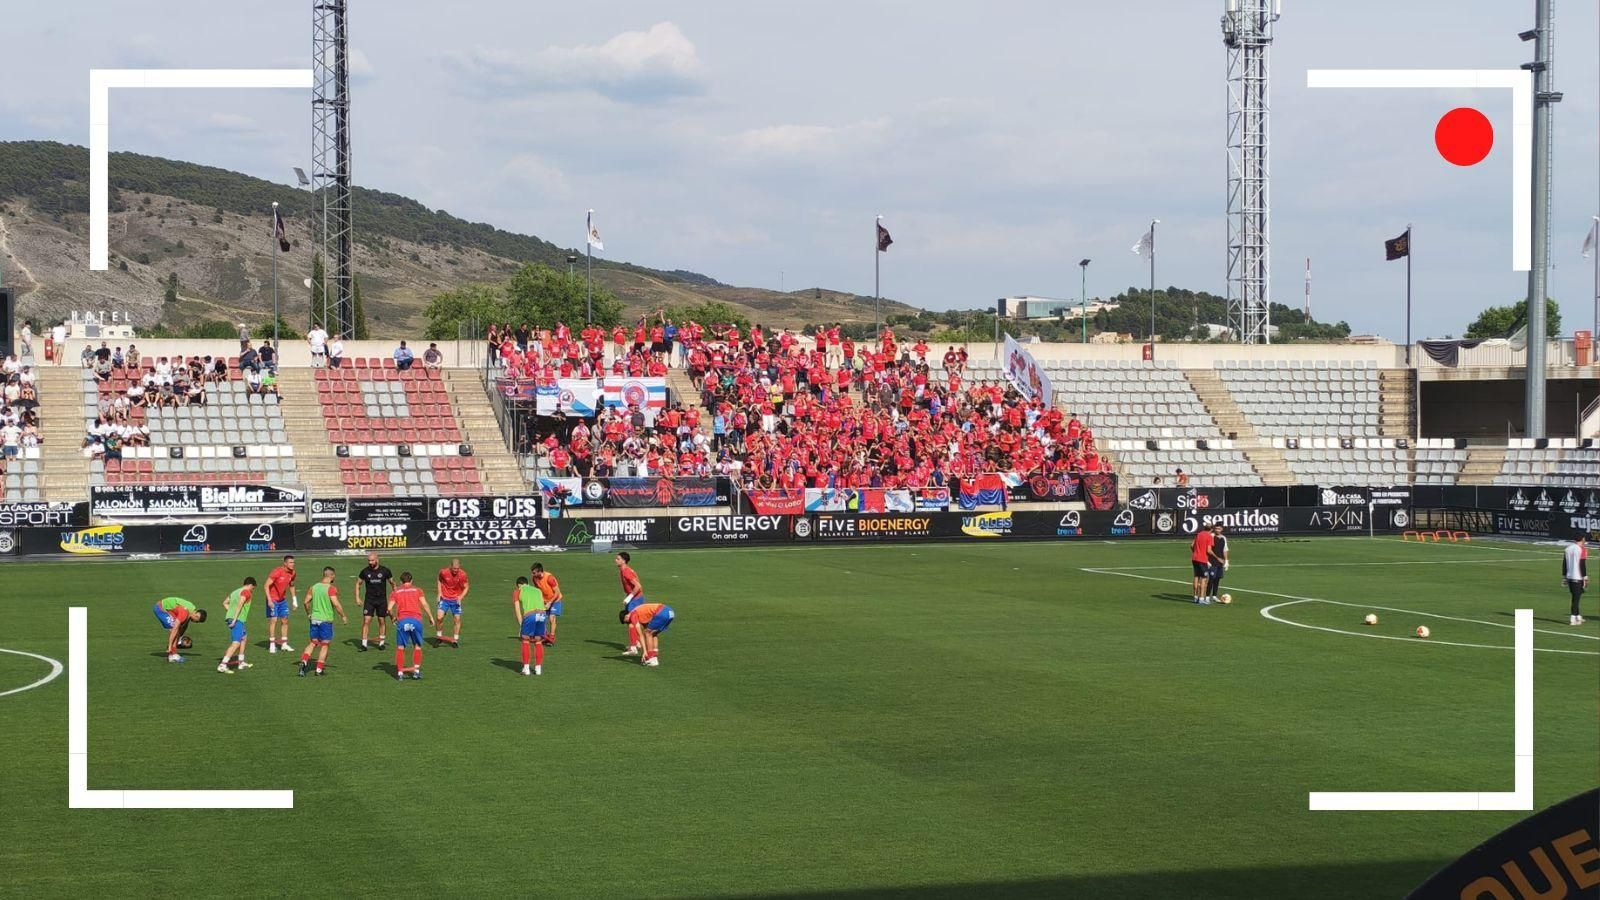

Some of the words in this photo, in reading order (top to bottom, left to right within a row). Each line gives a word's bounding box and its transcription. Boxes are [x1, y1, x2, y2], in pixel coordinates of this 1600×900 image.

[71, 310, 131, 322] HOTEL
[201, 487, 264, 506] BigMat
[11, 503, 33, 511] CASA
[95, 500, 143, 509] SALOMON
[149, 499, 196, 508] SALOMON
[0, 511, 73, 525] SPORT
[678, 516, 781, 531] GRENERGY
[819, 519, 854, 531] FIVE
[859, 518, 930, 531] BIOENERGY
[962, 517, 1013, 529] VIALES
[1203, 509, 1279, 527] sentidos
[1309, 506, 1362, 530] ARKIN
[1498, 517, 1520, 530] FIVE
[1520, 519, 1550, 530] WORKS
[1570, 513, 1600, 533] ruja
[312, 521, 407, 540] rujamar
[437, 520, 536, 530] CERVEZAS
[61, 532, 124, 545] VIALES
[427, 528, 546, 541] VICTORIA
[180, 543, 210, 551] trendit
[246, 542, 276, 550] trendit
[347, 536, 407, 548] SPORTSTEAM
